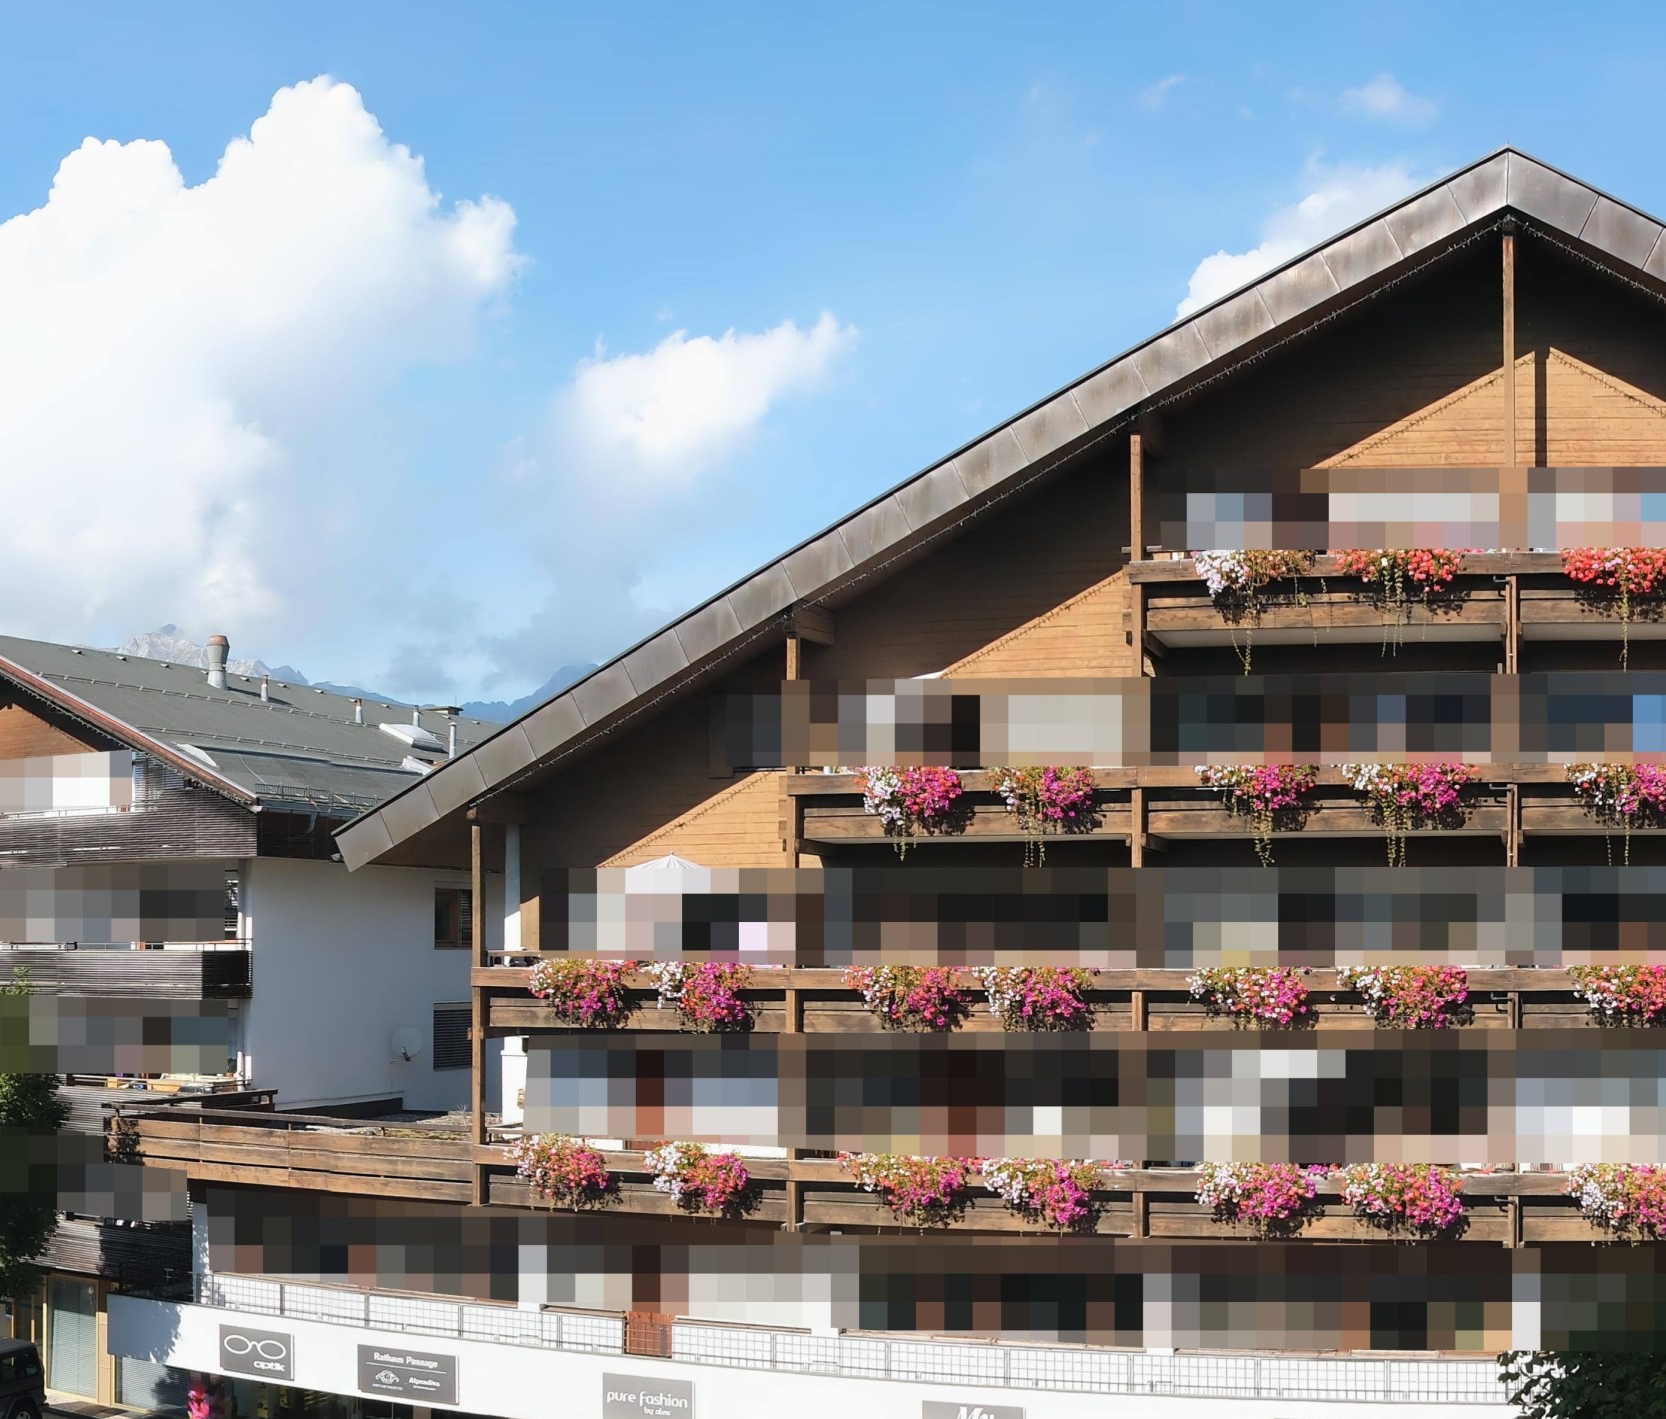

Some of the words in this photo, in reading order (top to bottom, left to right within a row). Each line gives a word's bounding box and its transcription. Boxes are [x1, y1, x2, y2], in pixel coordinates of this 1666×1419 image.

[253, 1360, 286, 1372] optik
[373, 1351, 404, 1364] Rathaus
[406, 1356, 438, 1369] Passage
[606, 1391, 636, 1403] pure
[639, 1391, 688, 1408] fashion
